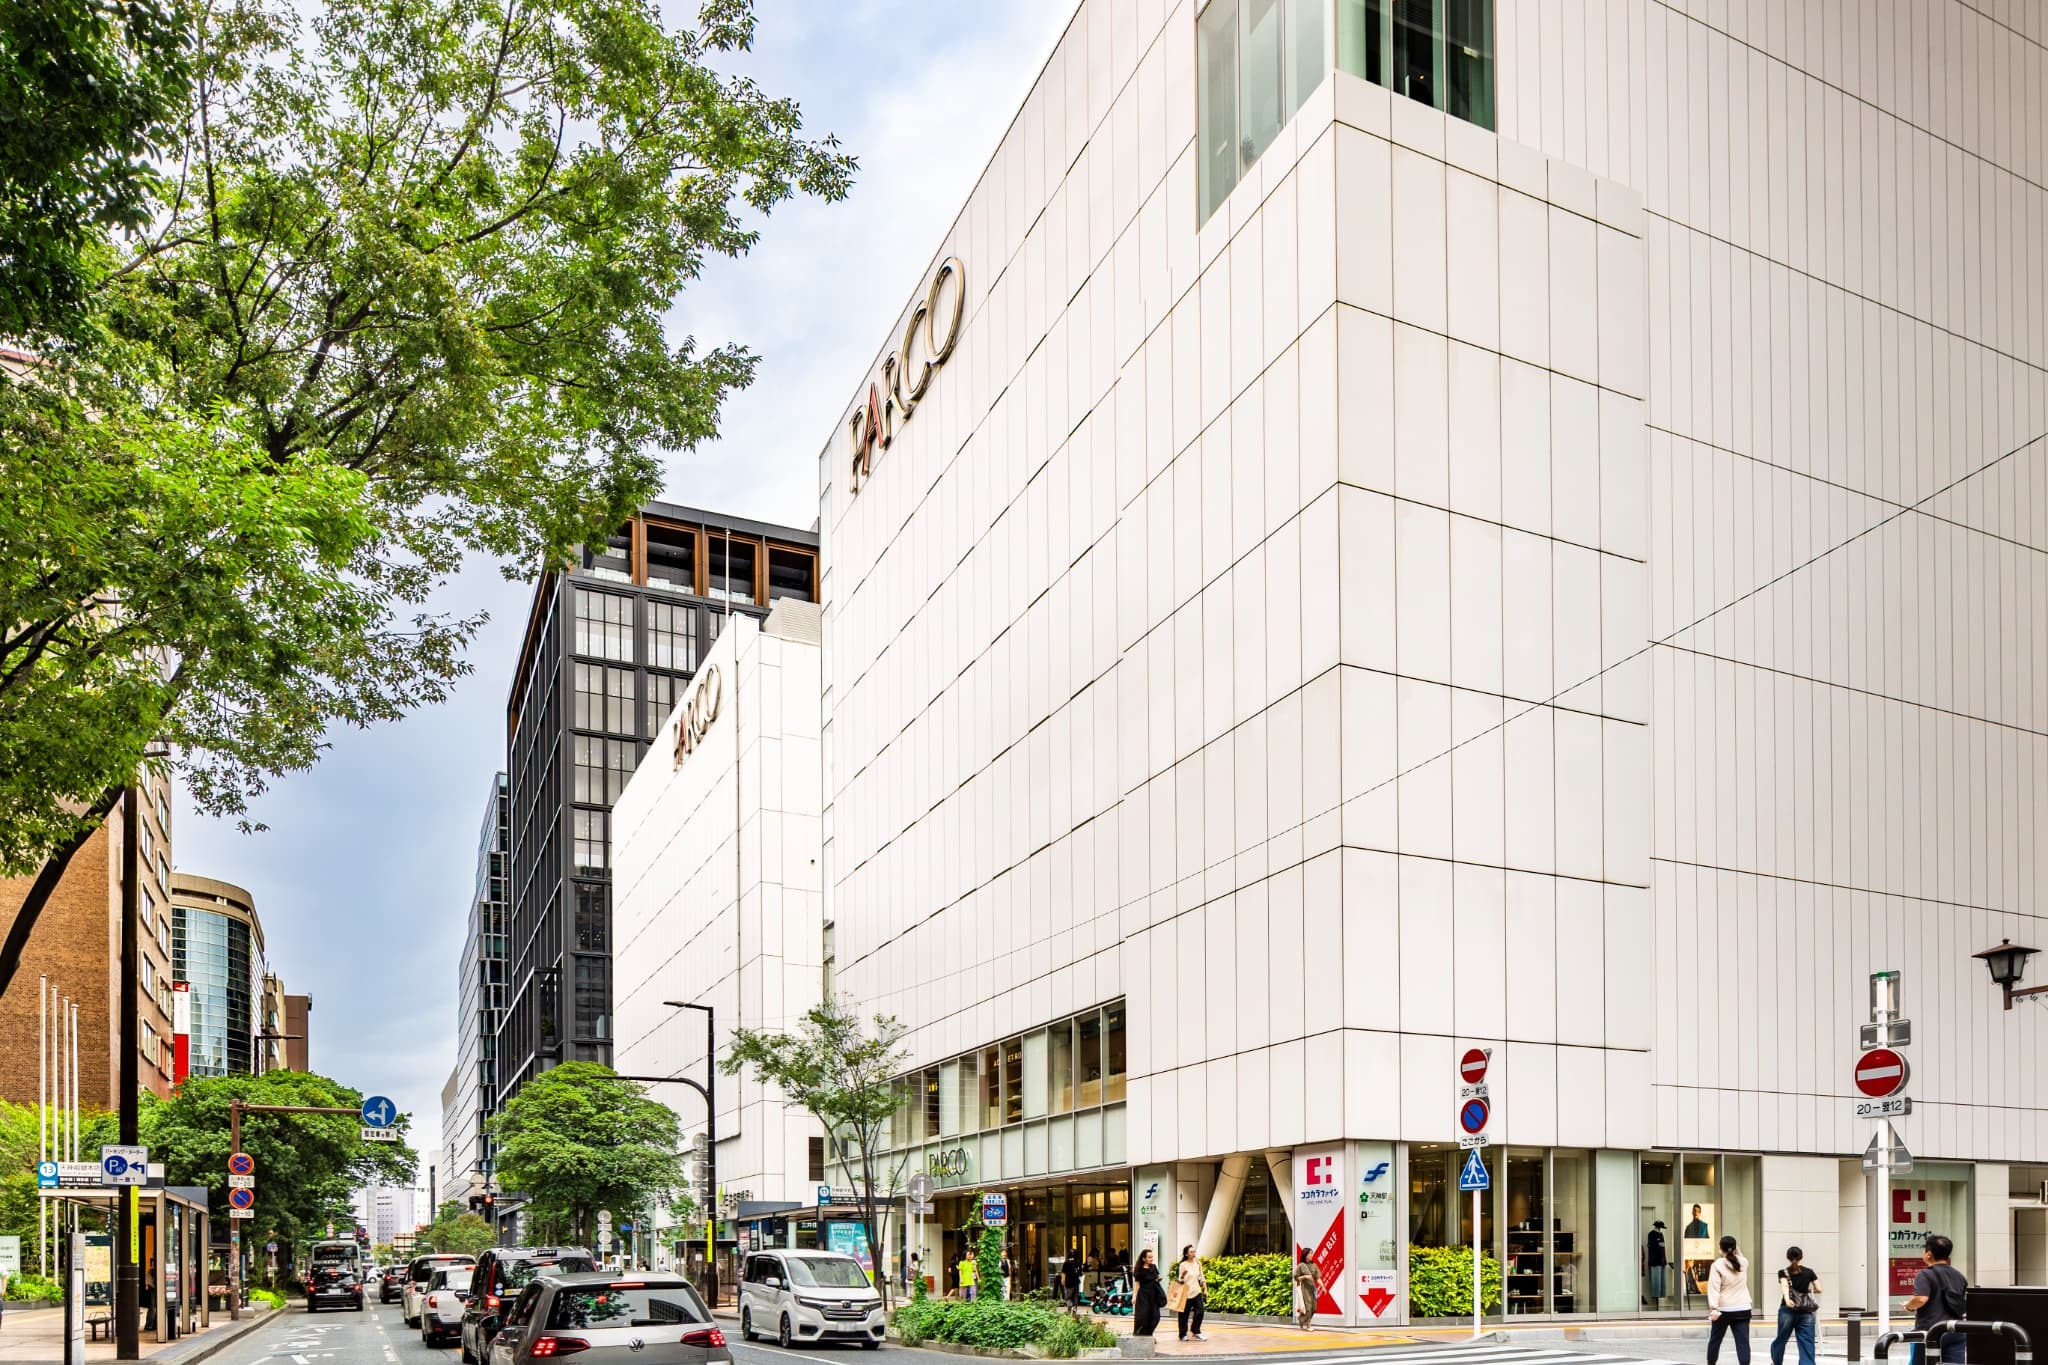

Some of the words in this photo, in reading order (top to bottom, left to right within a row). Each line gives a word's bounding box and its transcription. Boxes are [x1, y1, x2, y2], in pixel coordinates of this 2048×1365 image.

[849, 256, 966, 495] PARCO
[672, 663, 722, 772] PARCO
[1461, 1136, 1487, 1147] ここから
[43, 1165, 54, 1174] 13
[929, 1148, 967, 1178] PARCO
[1300, 1188, 1339, 1200] ココカラファイン
[1325, 1231, 1338, 1250] B1F
